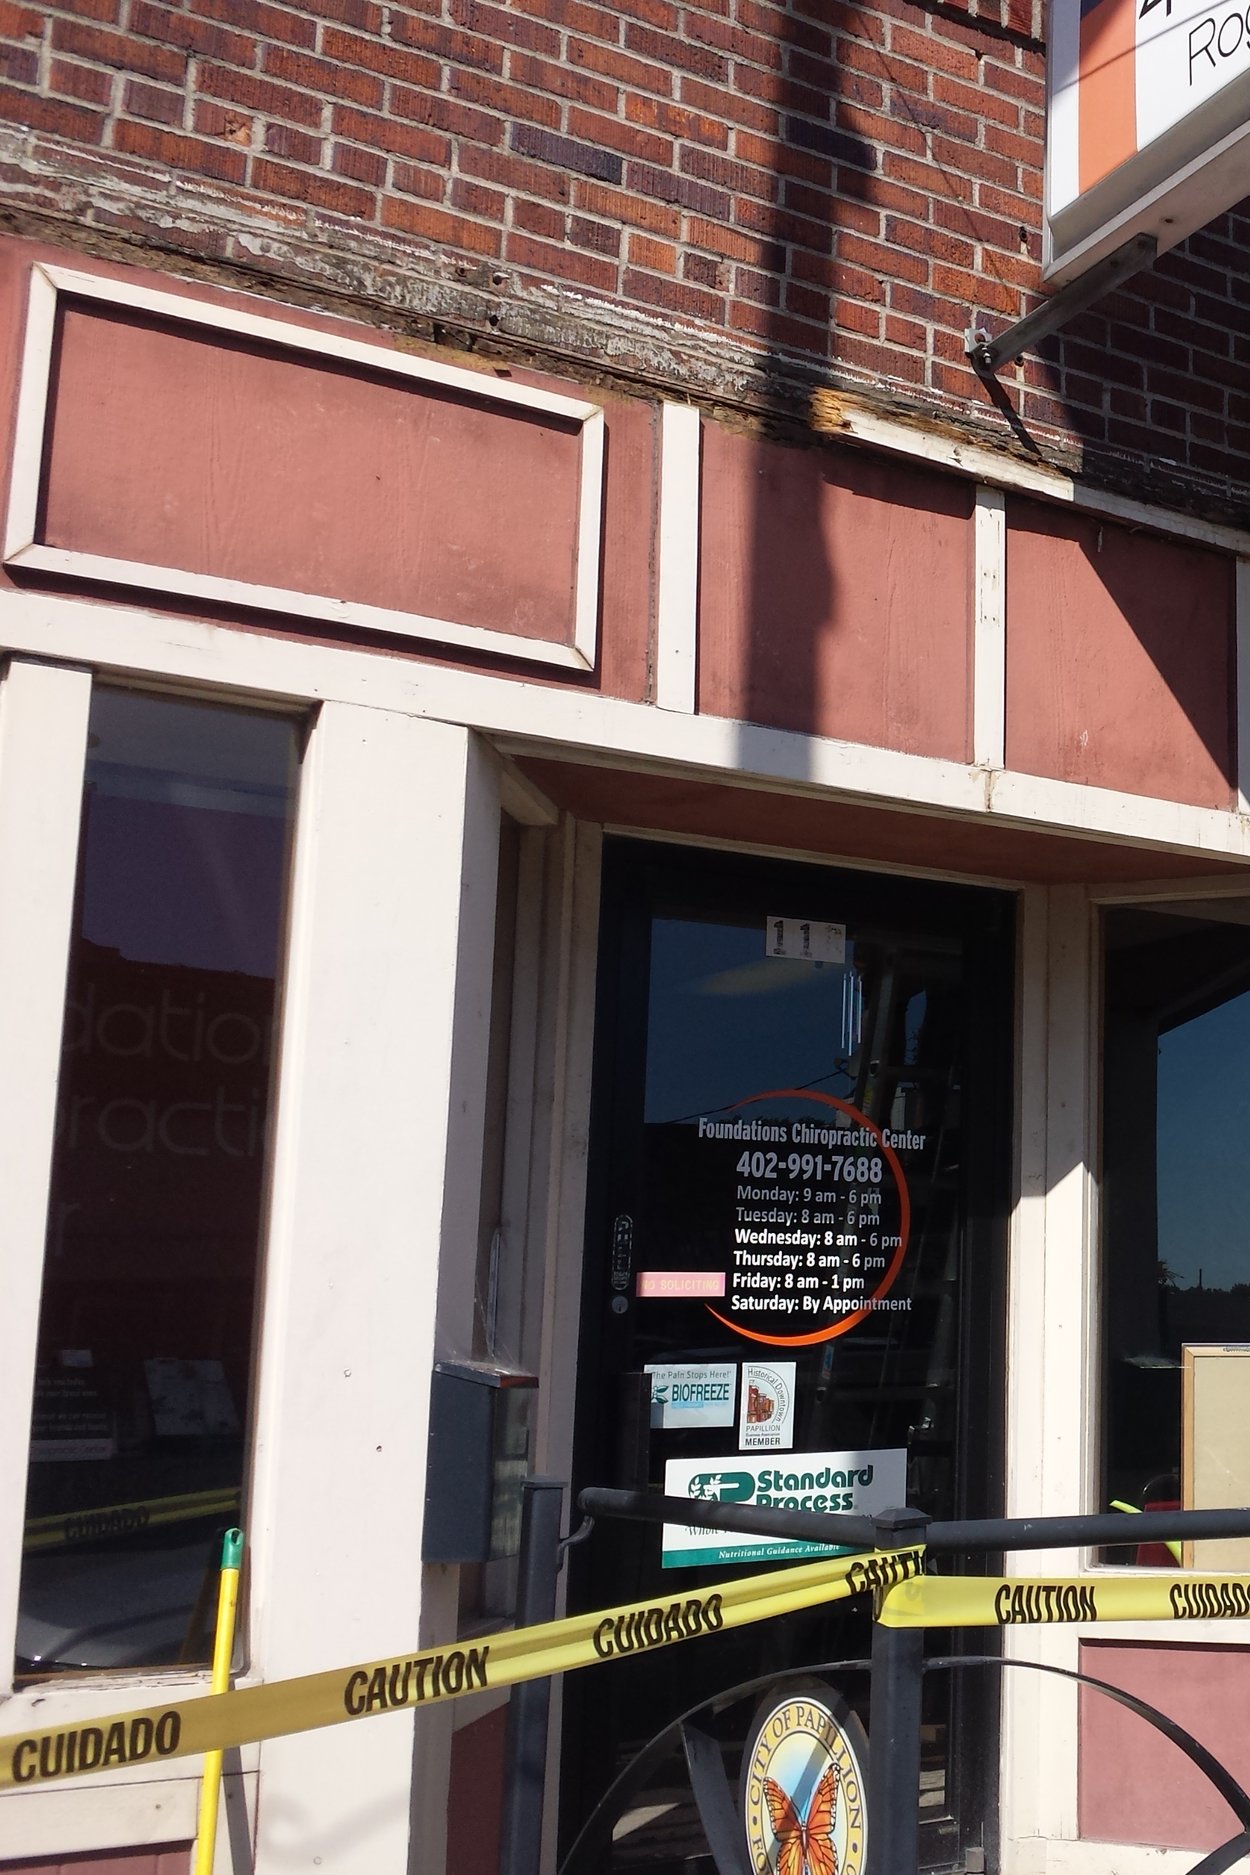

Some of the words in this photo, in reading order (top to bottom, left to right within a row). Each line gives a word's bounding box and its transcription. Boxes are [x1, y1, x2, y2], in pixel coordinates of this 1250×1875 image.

[698, 1117, 787, 1143] Foundations
[792, 1123, 878, 1149] Chiropractic
[882, 1128, 926, 1150] Center
[736, 1151, 883, 1183] 402-991-7688
[737, 1185, 799, 1204] Monday:
[803, 1188, 812, 1202] 9
[816, 1191, 837, 1203] am
[849, 1190, 857, 1203] 6
[861, 1193, 882, 1207] pm
[736, 1207, 797, 1226] Tuesday:
[801, 1209, 810, 1224] 8
[813, 1213, 835, 1224] am
[847, 1211, 856, 1225] 6
[859, 1214, 880, 1228] pm
[734, 1228, 821, 1249] Wednesday:
[824, 1231, 833, 1246] 8
[836, 1235, 858, 1247] am
[869, 1233, 877, 1247] 6
[881, 1236, 903, 1250] pm
[733, 1250, 803, 1270] Thursday:
[806, 1252, 815, 1267] 8
[818, 1255, 840, 1267] am
[852, 1254, 860, 1267] 6
[864, 1257, 885, 1270] pm
[641, 1279, 656, 1290] NO
[660, 1279, 720, 1290] SOLICITING
[732, 1272, 781, 1291] Friday:
[784, 1274, 793, 1289] 8
[797, 1277, 819, 1289] am
[831, 1275, 839, 1289] 1
[842, 1278, 864, 1292] pm
[731, 1294, 799, 1314] Saturday:
[803, 1296, 820, 1314] By
[823, 1296, 912, 1314] Appointment
[668, 1371, 684, 1379] Pain
[687, 1371, 708, 1380] Stops
[672, 1383, 730, 1401] BIOFREEZE
[748, 1368, 778, 1385] Historical
[774, 1382, 786, 1422] Downtown
[746, 1424, 780, 1432] PAPILLION
[745, 1437, 781, 1446] MEMBER
[756, 1464, 874, 1493] Standard
[718, 1546, 764, 1558] Nutritional
[766, 1545, 802, 1555] Guidance
[995, 1583, 1098, 1623] CAUTION
[12, 1711, 182, 1783] CUIDADO
[343, 1646, 490, 1716] CAUTION
[592, 1593, 724, 1658] CUIDADO
[845, 1551, 925, 1595] CAUTI
[750, 1735, 774, 1806] CITY
[772, 1708, 793, 1738] OF
[796, 1705, 861, 1830] PAPILLION
